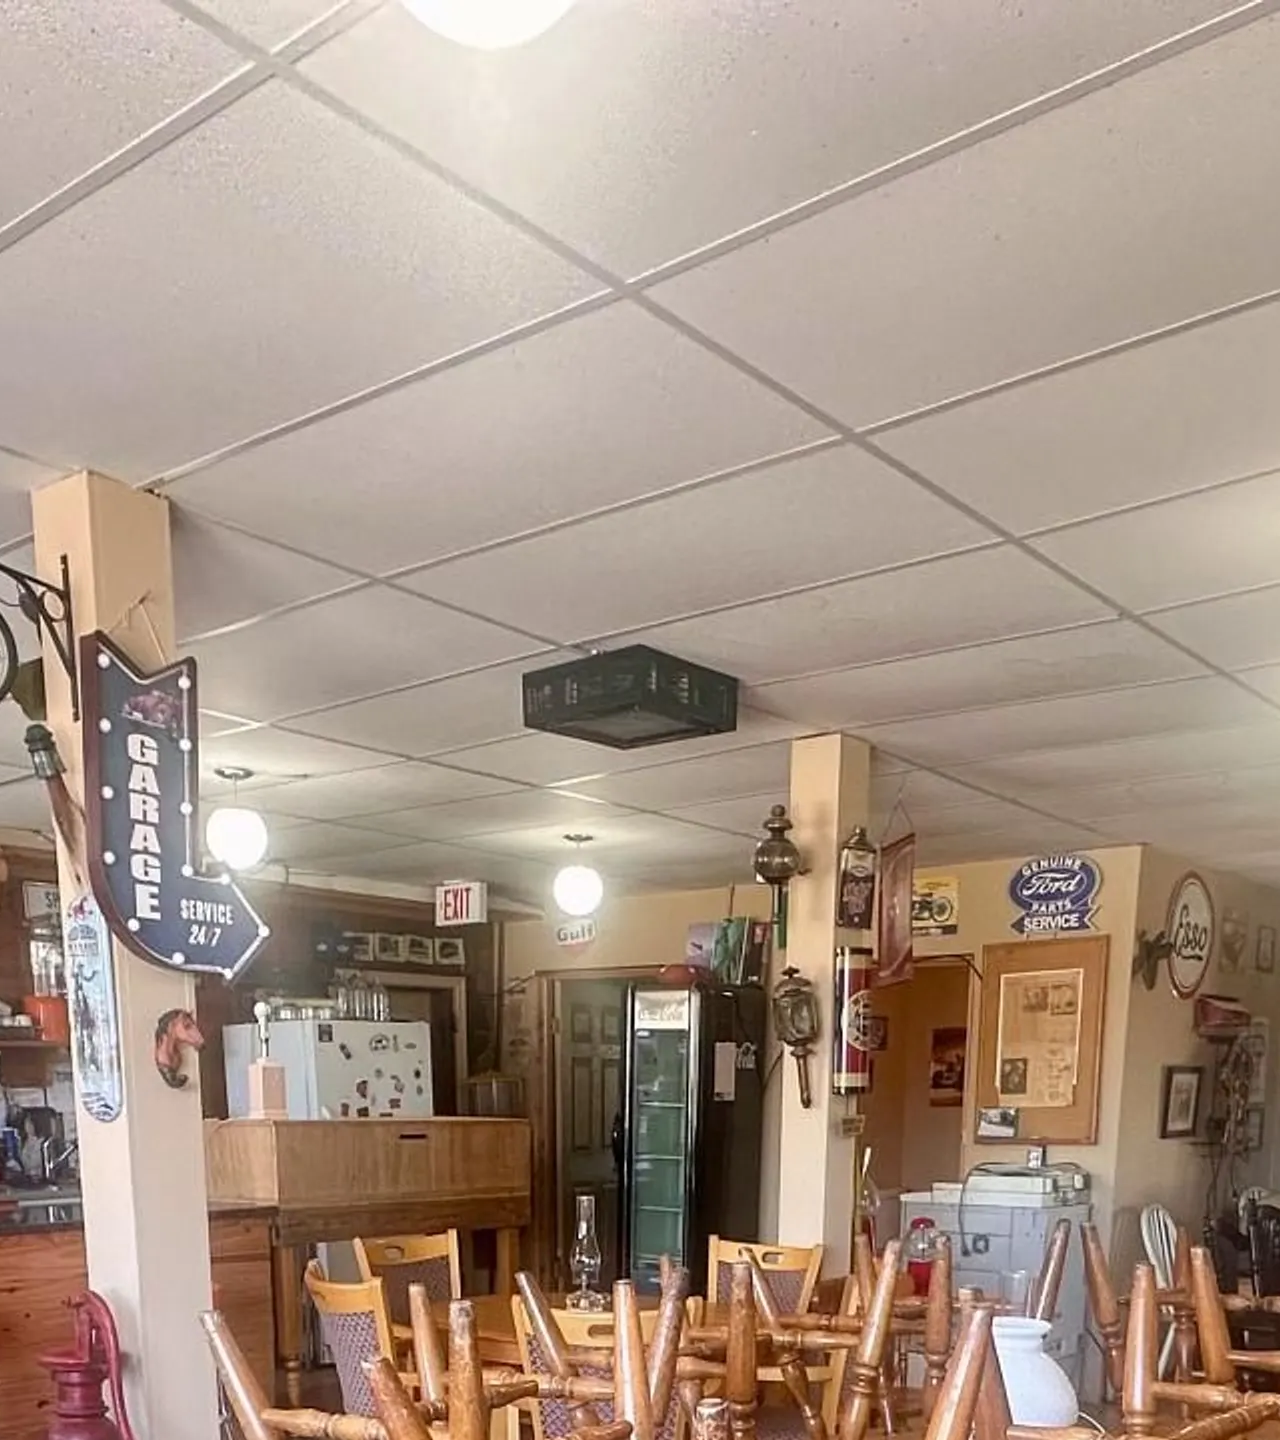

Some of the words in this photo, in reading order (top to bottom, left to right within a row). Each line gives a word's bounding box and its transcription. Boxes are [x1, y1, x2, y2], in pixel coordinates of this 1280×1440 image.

[127, 733, 161, 921] GARAGE
[1022, 855, 1081, 876] GENUINE
[1022, 873, 1081, 896] Ford
[180, 899, 234, 925] SERVICE
[444, 887, 471, 921] EXIT
[1032, 898, 1072, 915] PARTS
[557, 924, 594, 942] Gulf
[1024, 913, 1080, 932] SERVICE
[1173, 904, 1207, 957] Esso
[188, 924, 222, 946] 24/7
